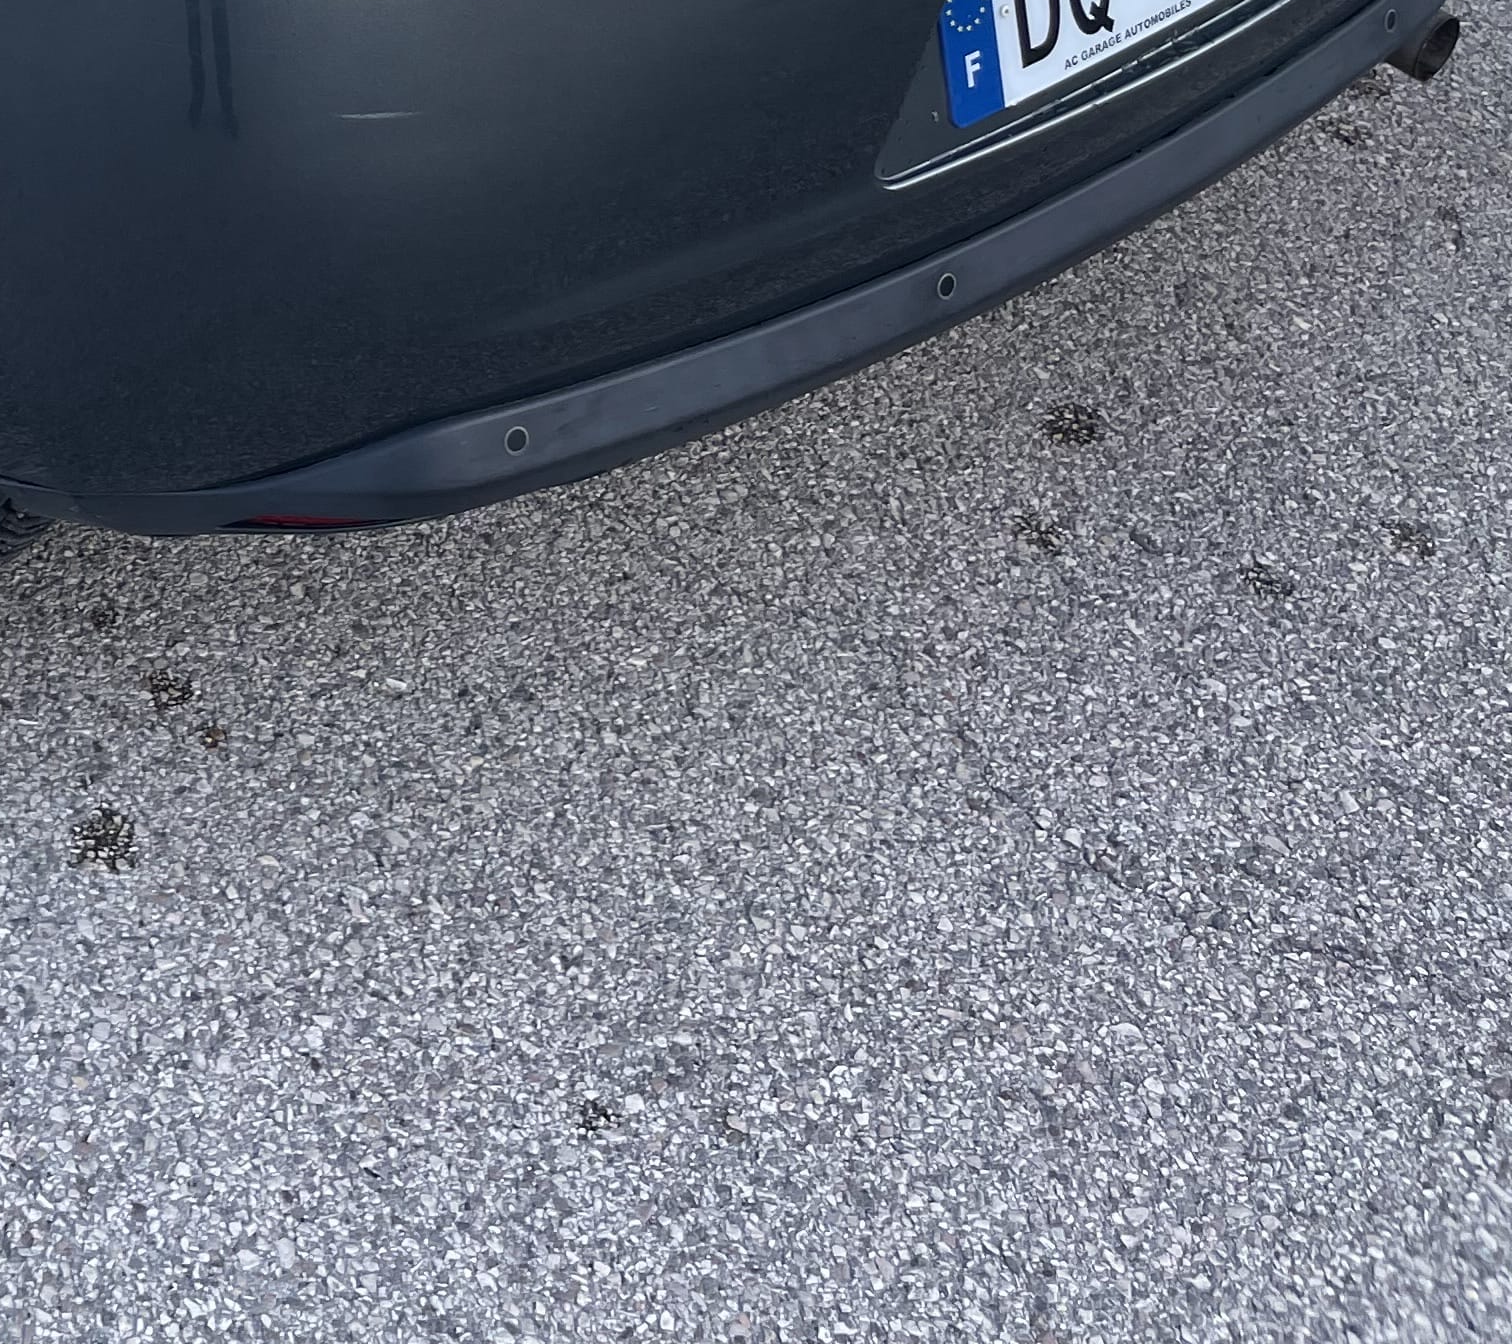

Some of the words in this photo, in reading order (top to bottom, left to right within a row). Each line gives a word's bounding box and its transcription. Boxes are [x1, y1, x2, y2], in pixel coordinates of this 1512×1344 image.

[964, 50, 983, 89] F
[1064, 55, 1079, 70] AC
[1081, 32, 1122, 61] GARAGE
